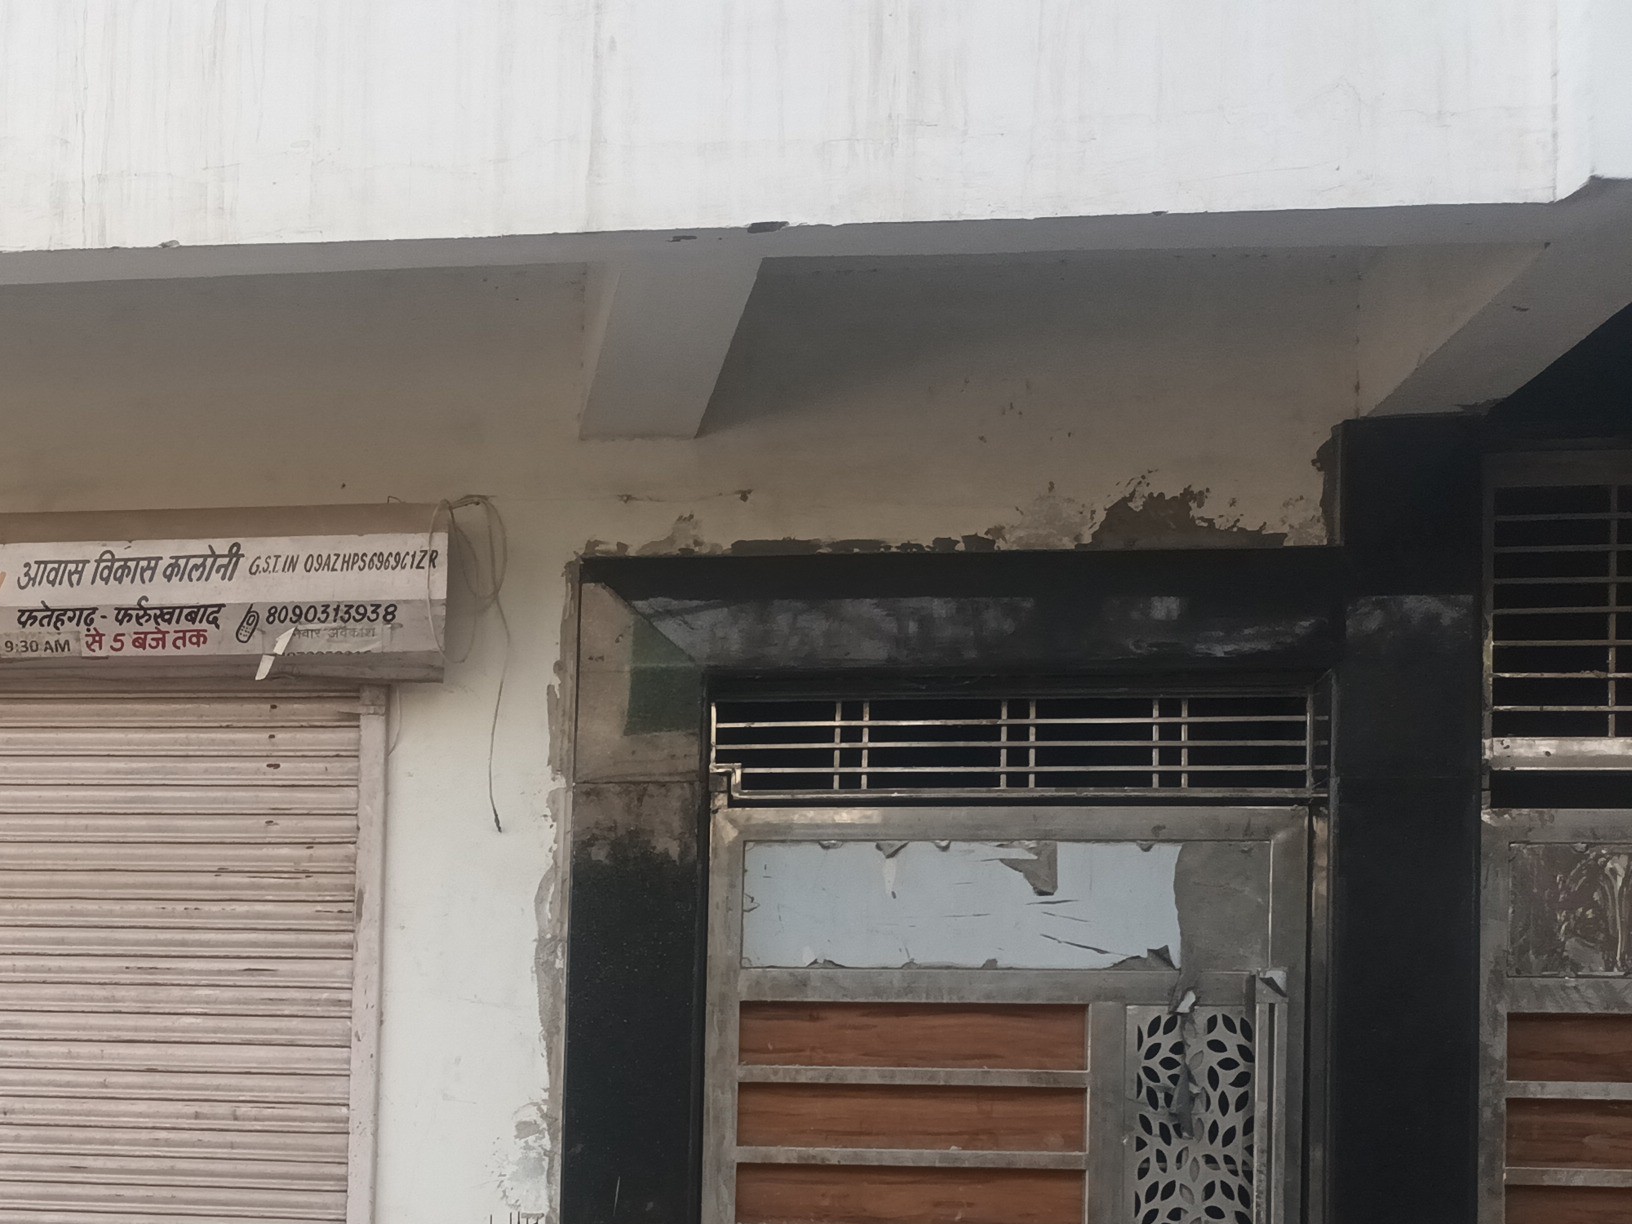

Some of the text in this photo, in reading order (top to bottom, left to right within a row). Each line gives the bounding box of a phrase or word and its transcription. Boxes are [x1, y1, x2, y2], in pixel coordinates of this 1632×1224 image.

[17, 542, 245, 590] आवास विकास कालोनी
[265, 603, 398, 625] 8090313938
[4, 626, 208, 653] 9:30 AM से 5 बजे तक
